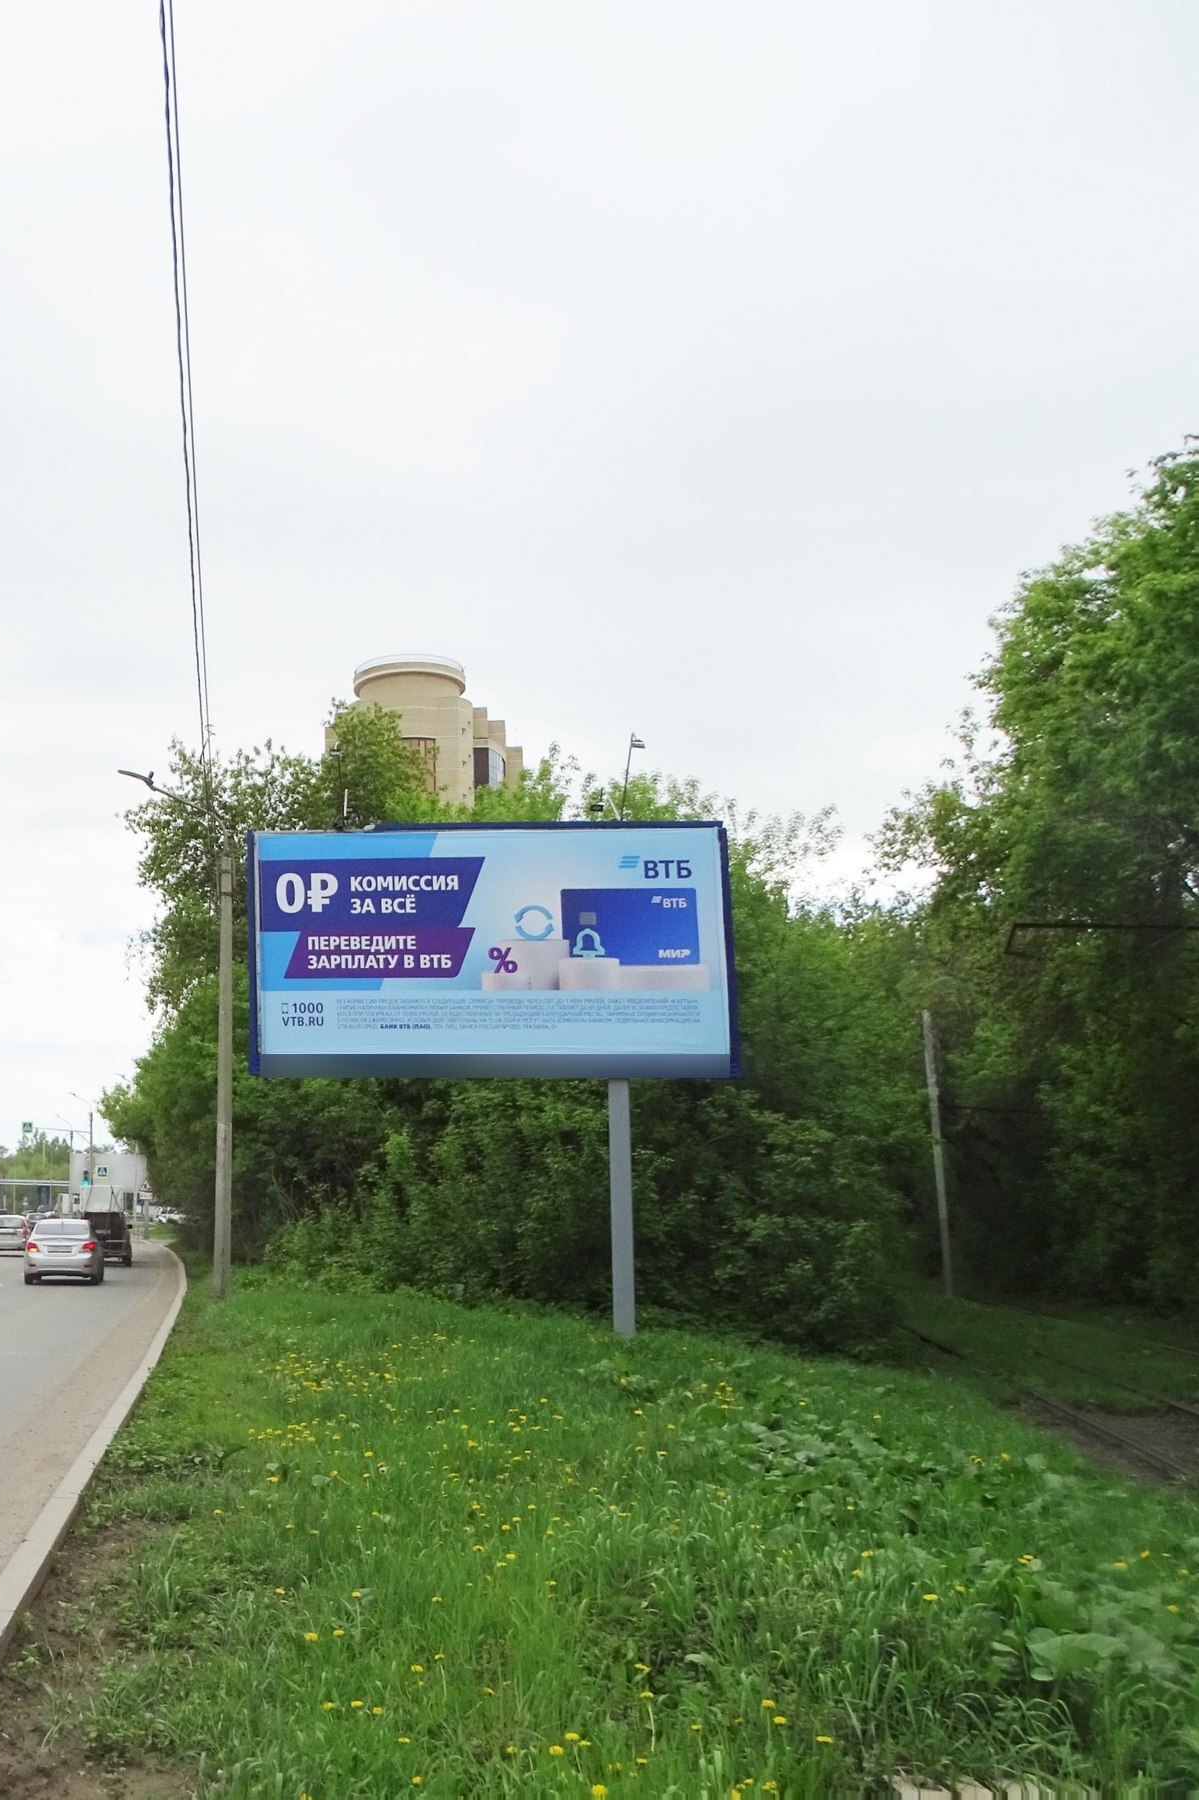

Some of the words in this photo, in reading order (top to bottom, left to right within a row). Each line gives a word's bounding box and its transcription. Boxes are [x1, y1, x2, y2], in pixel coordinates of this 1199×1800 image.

[644, 859, 692, 879] ВТБ
[350, 875, 459, 892] КОМИССИЯ
[350, 898, 376, 914] ЗА
[381, 894, 416, 914] ВСЁ
[663, 897, 687, 909] ВТБ
[307, 935, 416, 953] ПЕРЕВЕДИТЕ
[658, 948, 692, 959] МИР
[307, 954, 399, 970] ЗАРПЛАТУ
[403, 954, 414, 969] В
[420, 954, 452, 969] ВТБ
[292, 1002, 324, 1014] 1000
[282, 1016, 324, 1027] VTB.RU
